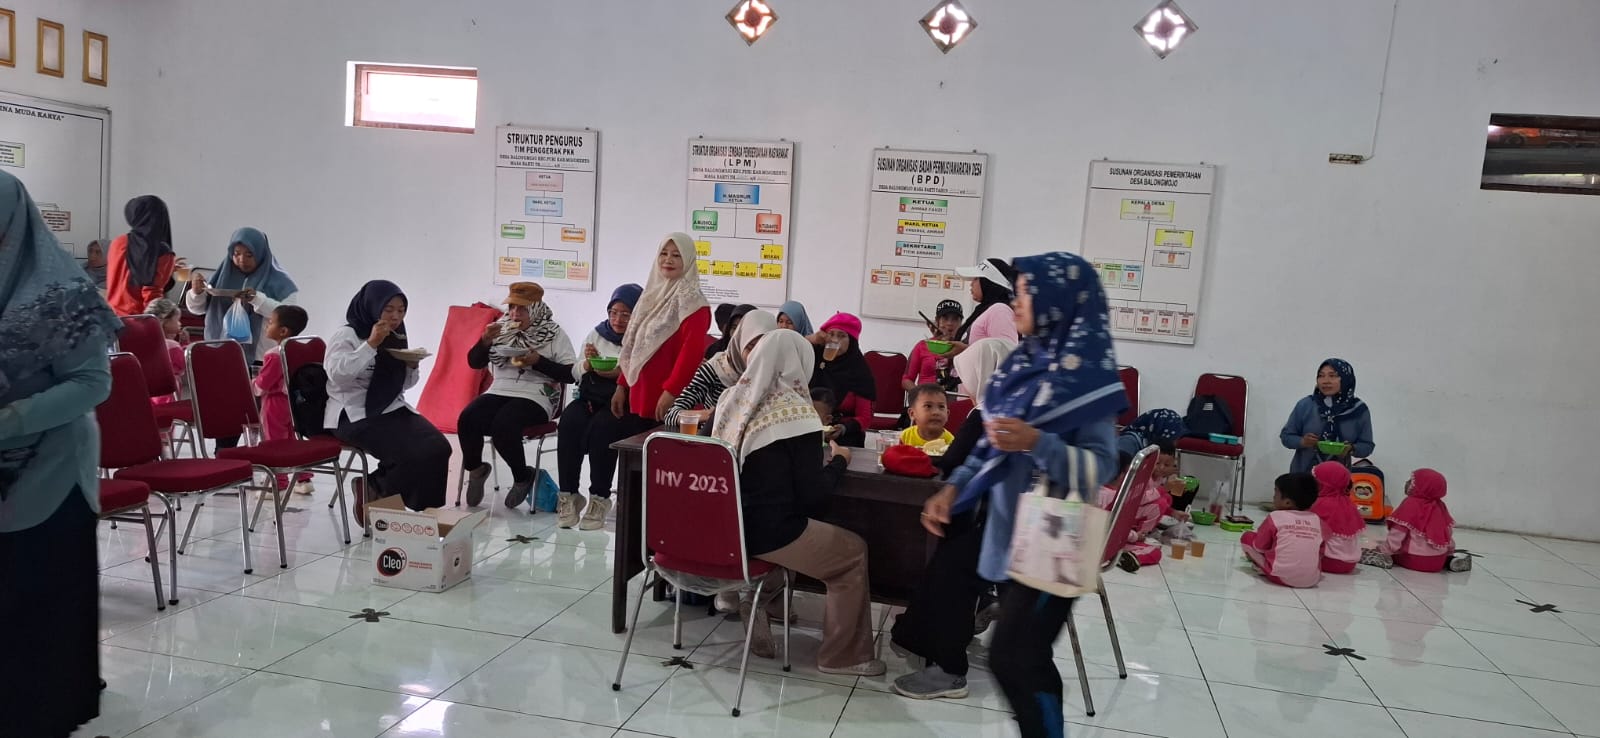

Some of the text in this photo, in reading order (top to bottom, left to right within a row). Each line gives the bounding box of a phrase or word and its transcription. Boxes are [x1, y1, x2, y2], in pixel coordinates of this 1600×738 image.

[15, 108, 36, 116] MUDA
[507, 133, 583, 147] STRUKTUR PENGURUS
[526, 146, 561, 155] PENGGERAK
[692, 145, 708, 156] STRUKTUR
[877, 157, 895, 171] SUSUNAN
[896, 158, 918, 172] ORGANISASI
[919, 159, 932, 173] BADAN
[972, 162, 982, 176] DESA
[1133, 169, 1162, 177] ORGANISASI
[1164, 171, 1201, 179] PEMERINTAHAN
[1144, 178, 1178, 187] BALONGMOJO
[938, 302, 961, 312] SPOR
[689, 473, 728, 494] 2023
[383, 555, 401, 569] Cleo
